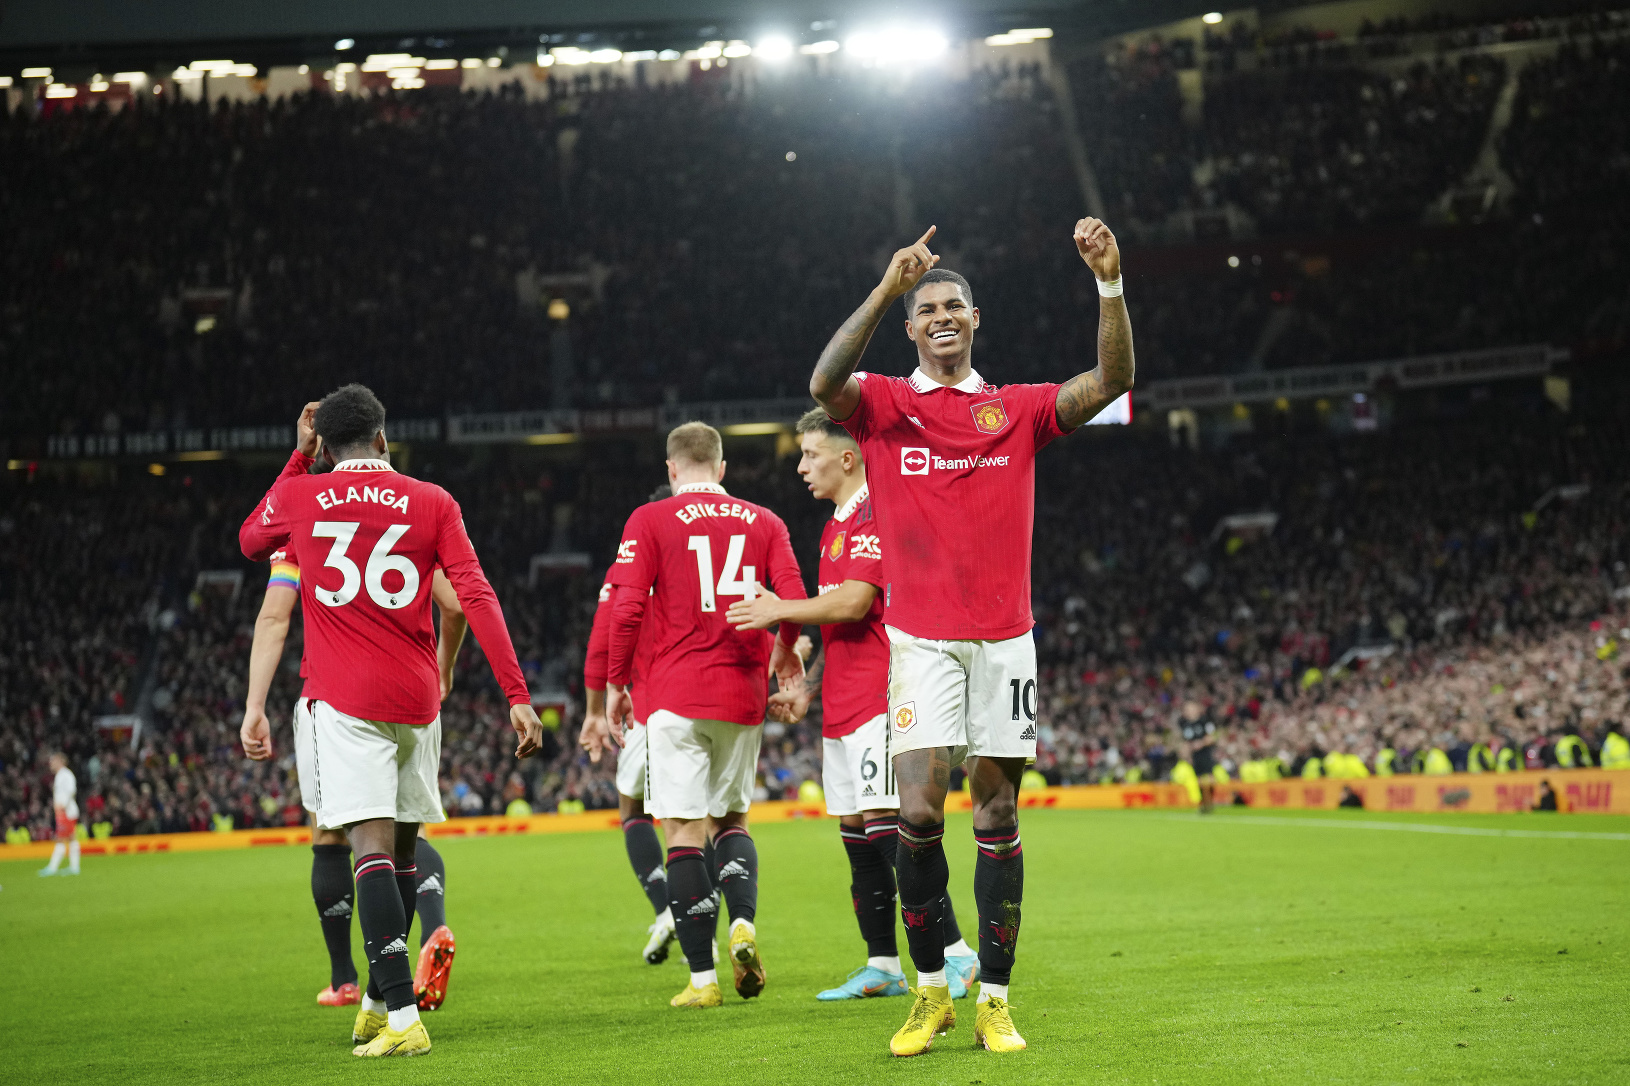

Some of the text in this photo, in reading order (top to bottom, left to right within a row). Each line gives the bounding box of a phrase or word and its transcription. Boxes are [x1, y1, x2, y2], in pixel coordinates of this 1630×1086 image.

[931, 453, 1010, 470] TeamViewer
[315, 485, 410, 515] ELANGA
[675, 503, 758, 525] ERIKSEN
[311, 521, 420, 610] 36
[687, 534, 761, 613] 14
[1009, 678, 1036, 721] 10
[860, 747, 878, 781] 6
